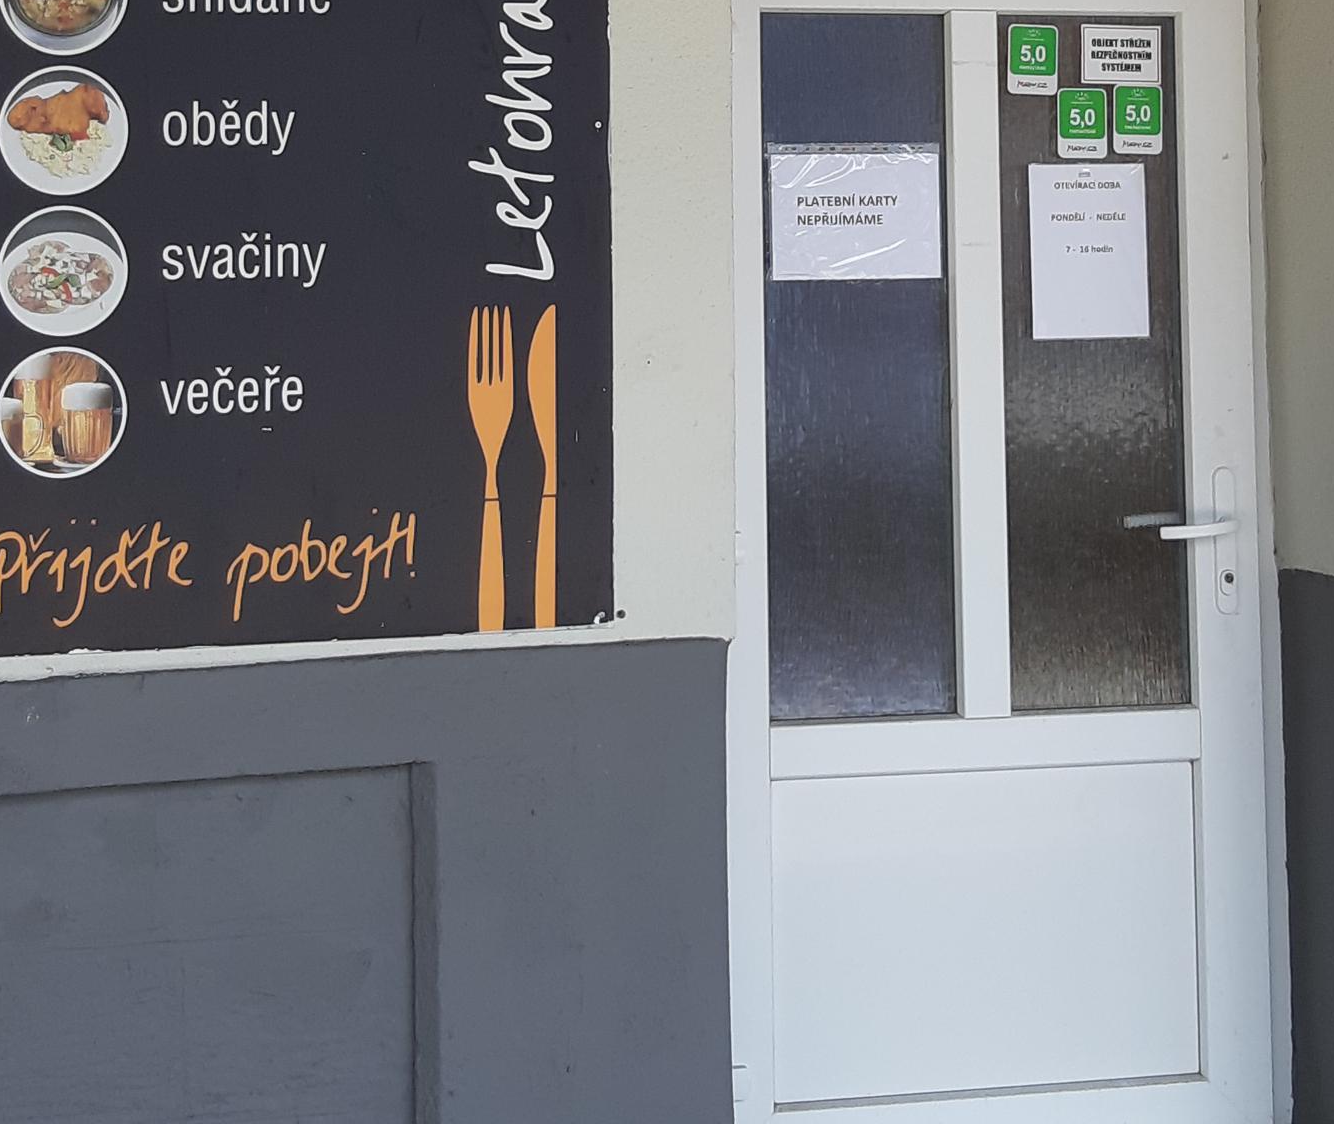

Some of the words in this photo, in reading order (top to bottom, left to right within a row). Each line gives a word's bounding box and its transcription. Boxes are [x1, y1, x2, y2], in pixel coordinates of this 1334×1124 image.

[1091, 38, 1118, 48] OBJEKT
[1120, 37, 1151, 48] STŘEŽEN
[1020, 44, 1047, 65] 5,0
[1090, 49, 1152, 60] BEZPEČNOSTNÍM
[1101, 62, 1142, 72] SYSTÉMEM
[1069, 108, 1096, 128] 5,0
[1125, 104, 1151, 124] 5,0
[161, 98, 296, 157] obědy
[1098, 182, 1122, 190] DOBA
[797, 193, 856, 207] PLATEBNÍ
[858, 195, 898, 207] KARTY
[797, 212, 884, 226] NEPŘIJÍMÁME
[1091, 245, 1114, 253] hodin
[161, 231, 328, 289] svačiny
[160, 364, 304, 416] večeře
[227, 508, 417, 622] pobejt!
